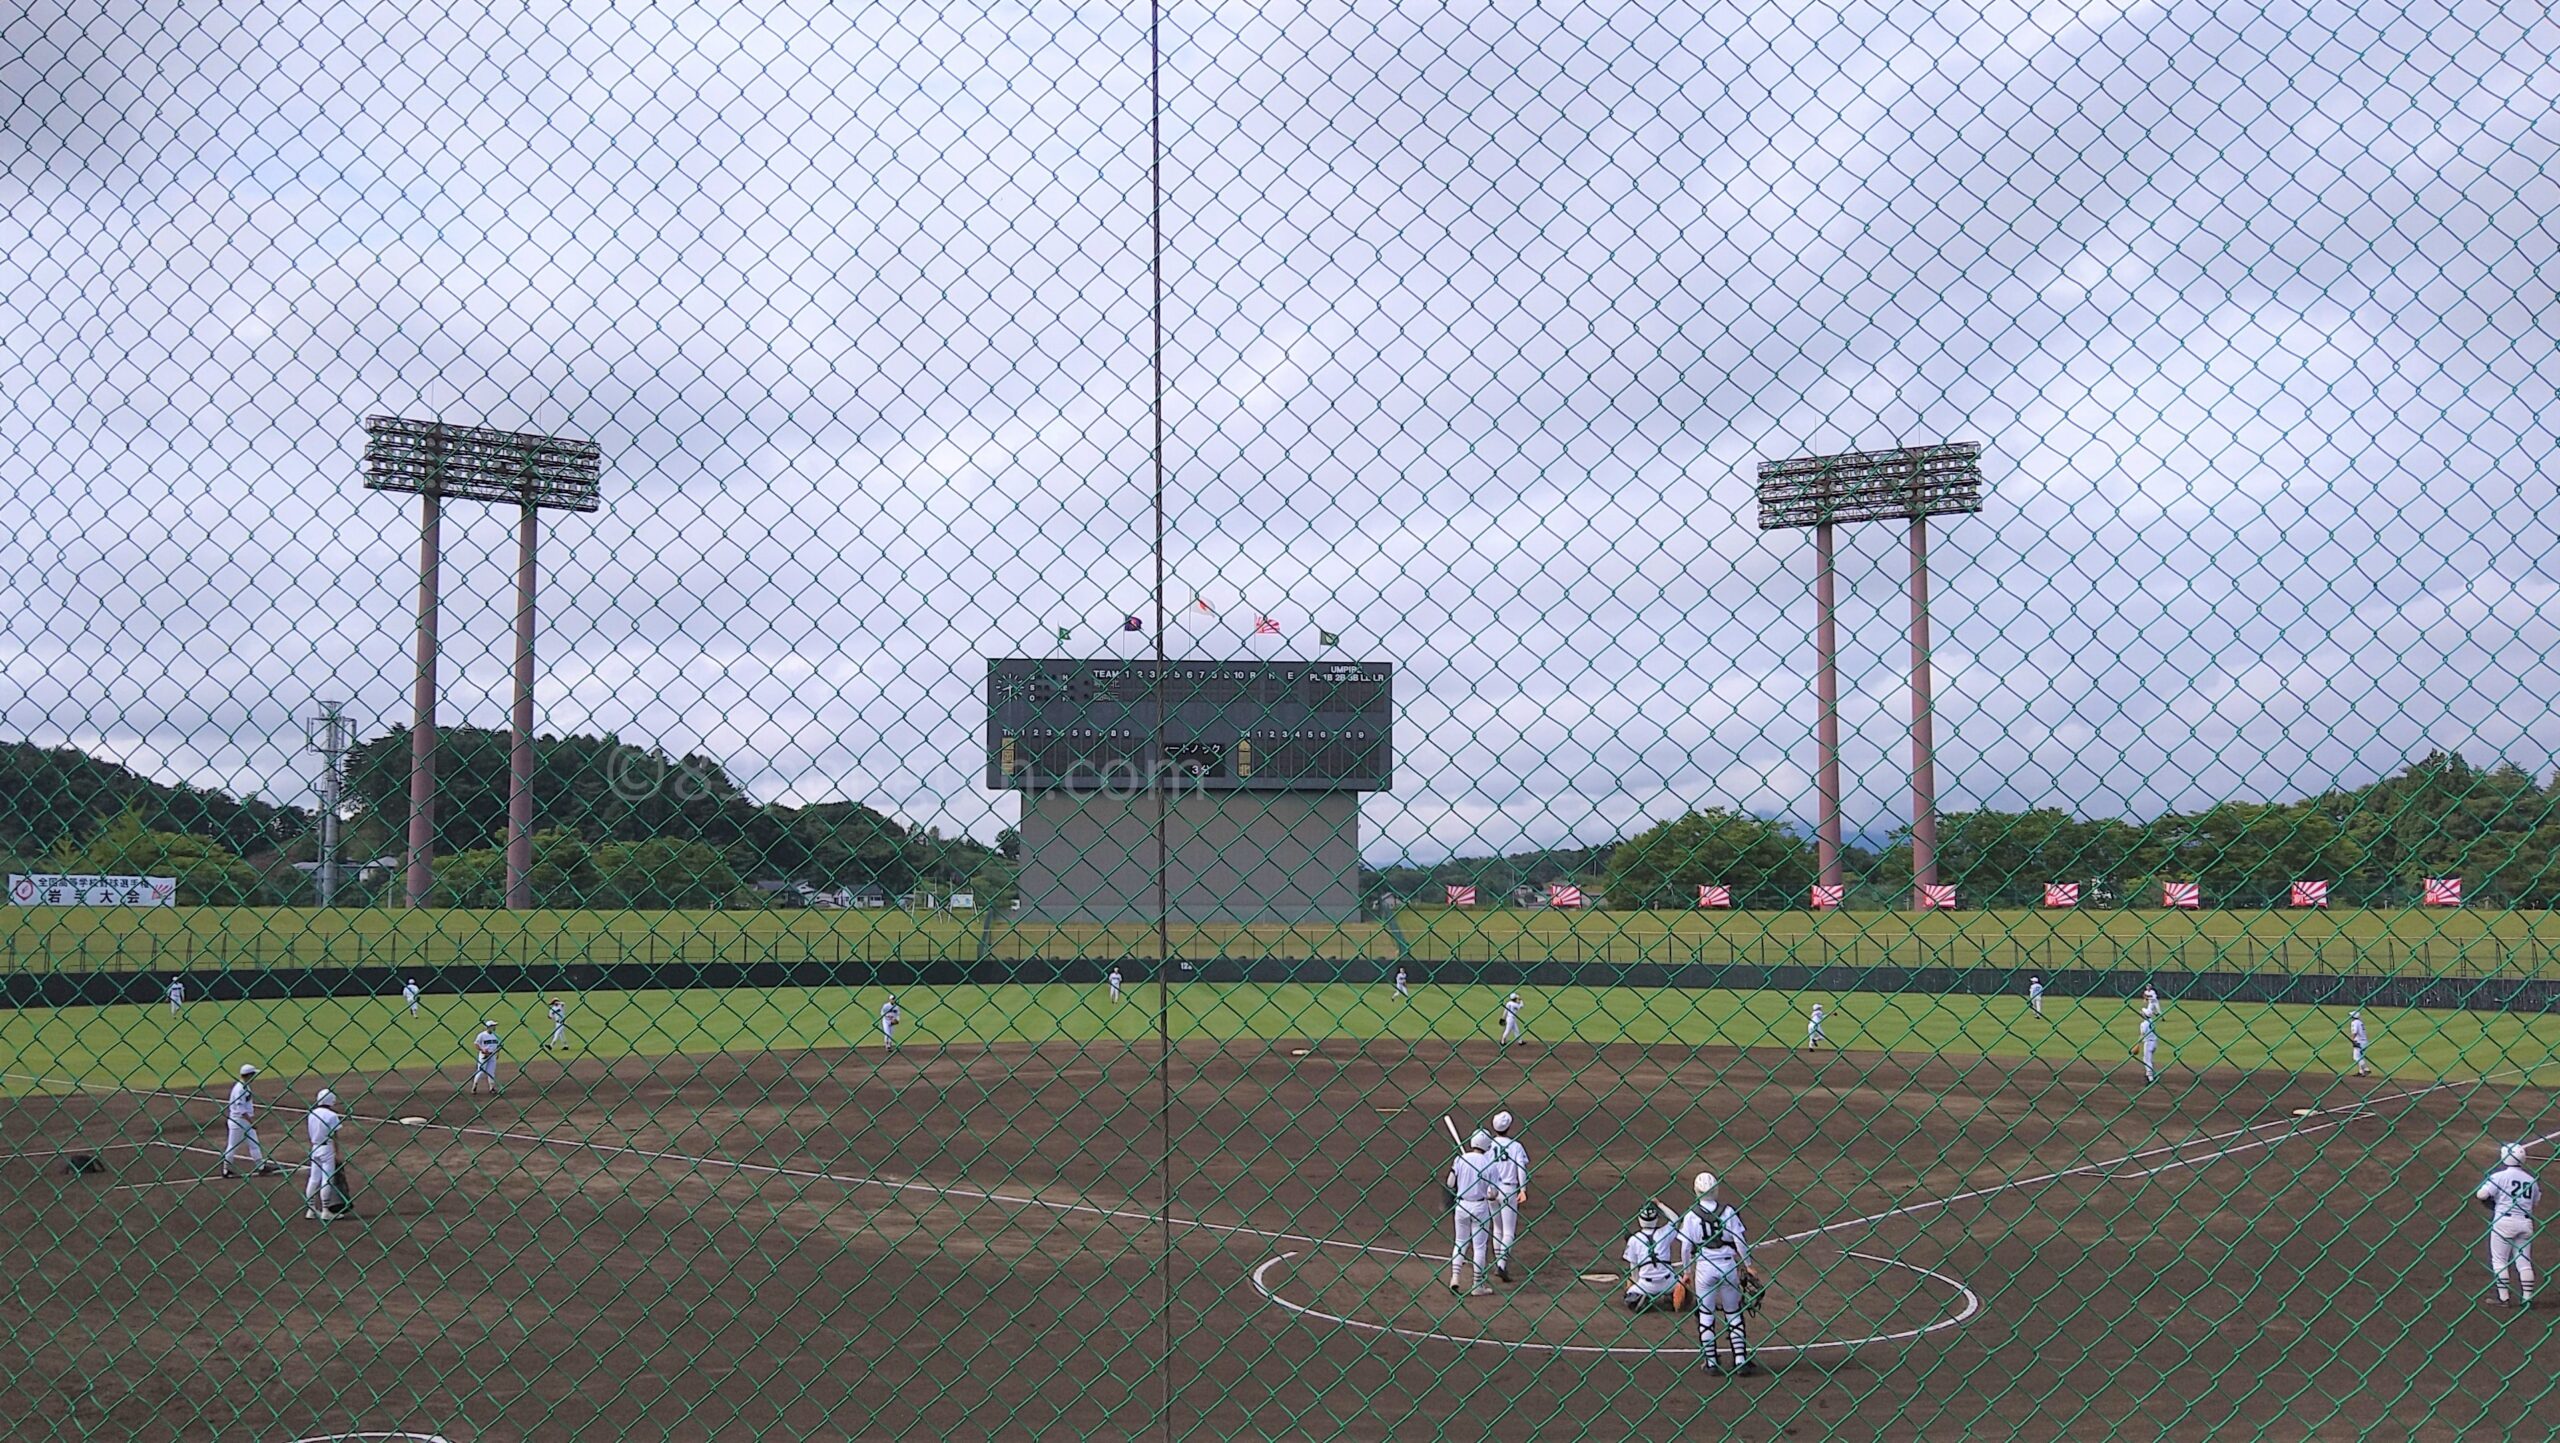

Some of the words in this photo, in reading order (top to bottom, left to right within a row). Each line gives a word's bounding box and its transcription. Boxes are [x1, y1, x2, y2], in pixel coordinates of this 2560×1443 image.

[1093, 670, 1120, 678] TEAM
[1137, 670, 1143, 678] 2
[1149, 670, 1156, 678] 3
[1187, 671, 1193, 679] 6
[1199, 671, 1205, 679] 7
[1234, 671, 1244, 679] 10
[1162, 743, 1221, 755] ートノック
[2510, 1180, 2533, 1200] 20
